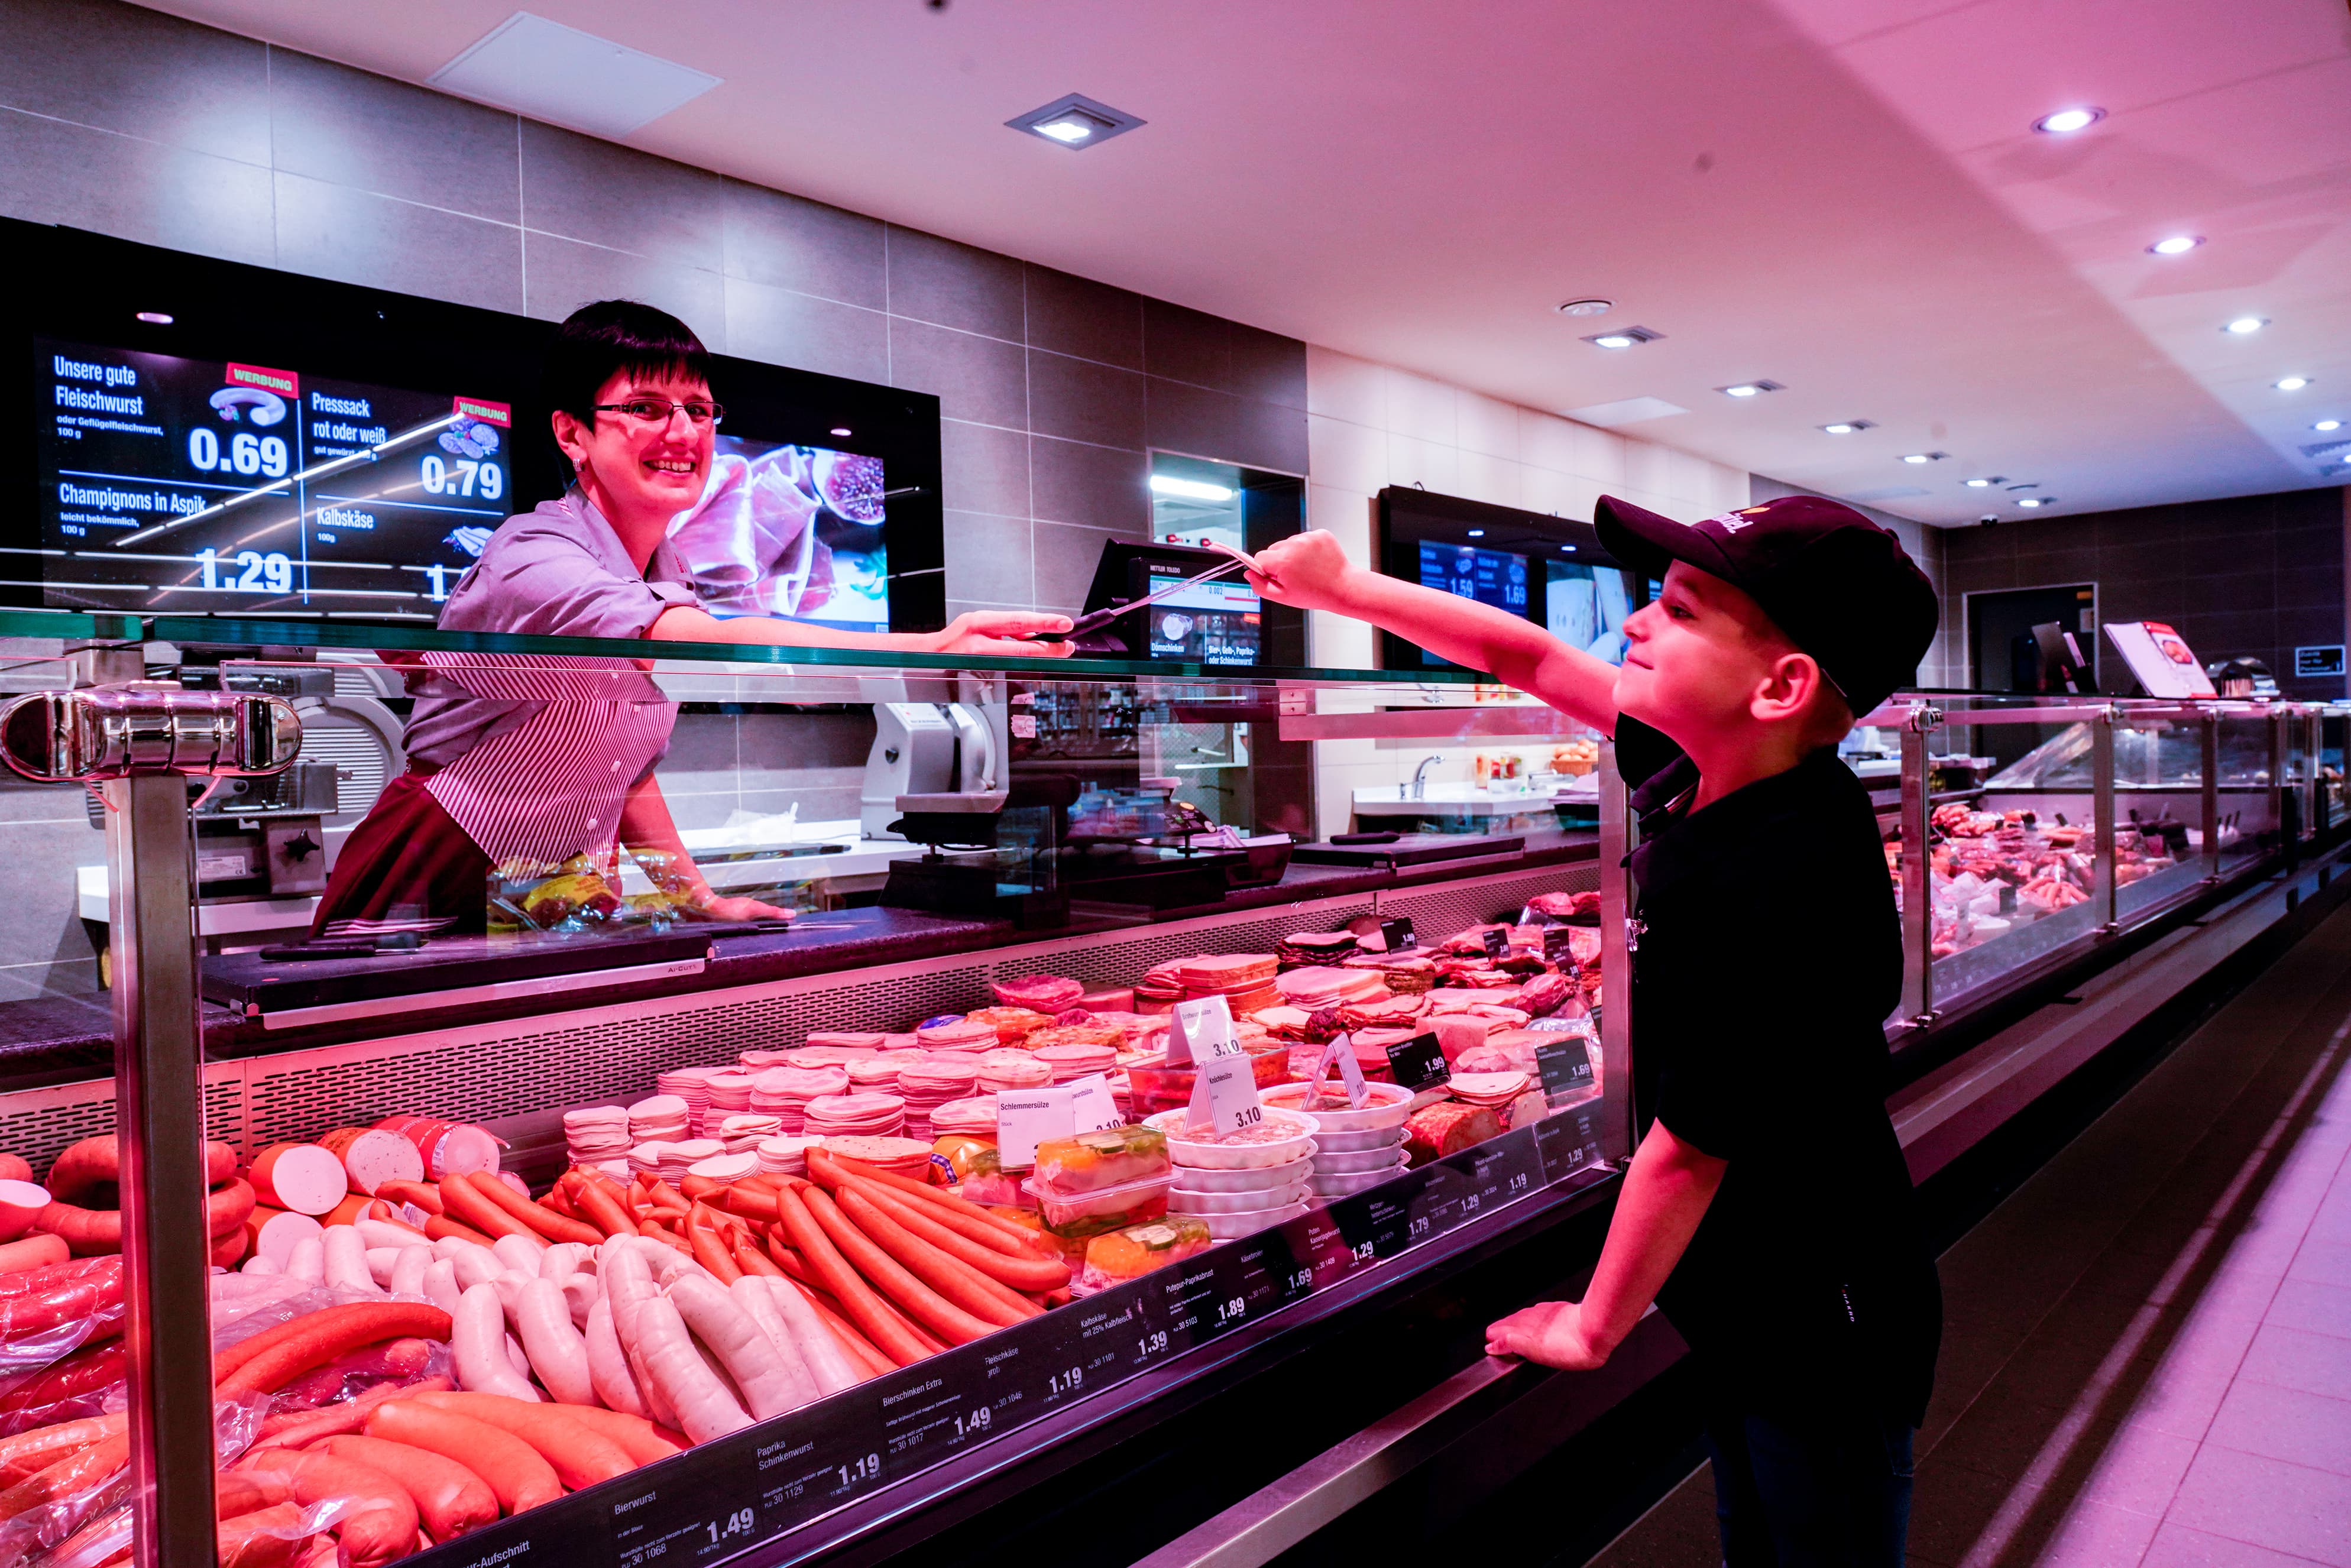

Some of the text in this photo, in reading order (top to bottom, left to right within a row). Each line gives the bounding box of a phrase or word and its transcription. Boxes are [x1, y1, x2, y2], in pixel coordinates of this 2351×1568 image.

[54, 355, 135, 387] Unsere gute
[234, 369, 292, 391] WERBUNG
[56, 385, 144, 416] Fleischwurst
[312, 391, 371, 417] Presssack
[459, 401, 507, 422] WERBUNG
[57, 415, 164, 436] oder Geflügelfleischwurst,
[57, 427, 82, 440] 100 g
[313, 421, 386, 445] rot oder weiß
[190, 427, 288, 478] 0.69
[314, 446, 377, 461] gut g
[422, 455, 502, 500] 0.79
[60, 483, 206, 516] Champignons in Aspik
[60, 512, 140, 528] leicht bekömmlich,
[316, 507, 374, 529] Kalbskäse
[61, 525, 85, 536] 100 g
[318, 533, 336, 543] 100g
[195, 548, 292, 593] 1.29
[1150, 565, 1165, 573] METTLER
[1450, 577, 1474, 599] 1.59
[1505, 584, 1527, 605] 1.69
[1213, 1039, 1239, 1057] 3.10
[1425, 1056, 1445, 1072] 1.99
[1572, 1063, 1590, 1077] 1.69
[1209, 1073, 1233, 1084] Knöchlesülze
[1000, 1102, 1050, 1111] Schlemmersülze
[1235, 1106, 1261, 1128] 3.10
[1568, 1148, 1583, 1164] 1.29
[1510, 1172, 1527, 1190] 1.19
[1461, 1194, 1479, 1211] 1.29
[1309, 1227, 1320, 1236] Puten
[1409, 1216, 1429, 1235] 1.79
[1352, 1240, 1374, 1261] 1.29
[1319, 1261, 1325, 1269] 30
[1325, 1257, 1335, 1266] 1409
[1165, 1269, 1214, 1294] Putepur-Paprikabrust
[1288, 1268, 1312, 1289] 1.69
[1259, 1285, 1270, 1295] 1171
[1218, 1297, 1245, 1320] 1.89
[1081, 1313, 1107, 1329] Kalbskäse
[1092, 1325, 1104, 1335] 25%
[1105, 1314, 1132, 1330] Kalbfleisch
[1178, 1321, 1185, 1330] 30
[1186, 1316, 1197, 1327] 5103
[1138, 1330, 1168, 1356] 1.39
[985, 1347, 1019, 1366] Fleischkäse
[1094, 1358, 1101, 1367] 30
[1102, 1352, 1115, 1363] 1101
[987, 1366, 1000, 1379] grob
[1049, 1366, 1082, 1394] 1.19
[883, 1378, 943, 1407] Bierschinken Extra
[999, 1398, 1006, 1408] 30
[1008, 1391, 1022, 1403] 1046
[954, 1406, 991, 1436] 1.49
[757, 1440, 786, 1458] Paprika
[898, 1440, 906, 1451] 30
[908, 1433, 924, 1446] 1017
[759, 1440, 814, 1470] Schinkenwurst
[838, 1453, 880, 1486] 1.19
[615, 1491, 656, 1515] Bierwurst
[773, 1493, 783, 1505] 30
[785, 1485, 804, 1499] 1129
[707, 1507, 754, 1543] 1.49
[632, 1553, 643, 1566] 30
[645, 1543, 666, 1559] 1068
[645, 1540, 656, 1548] nicht
